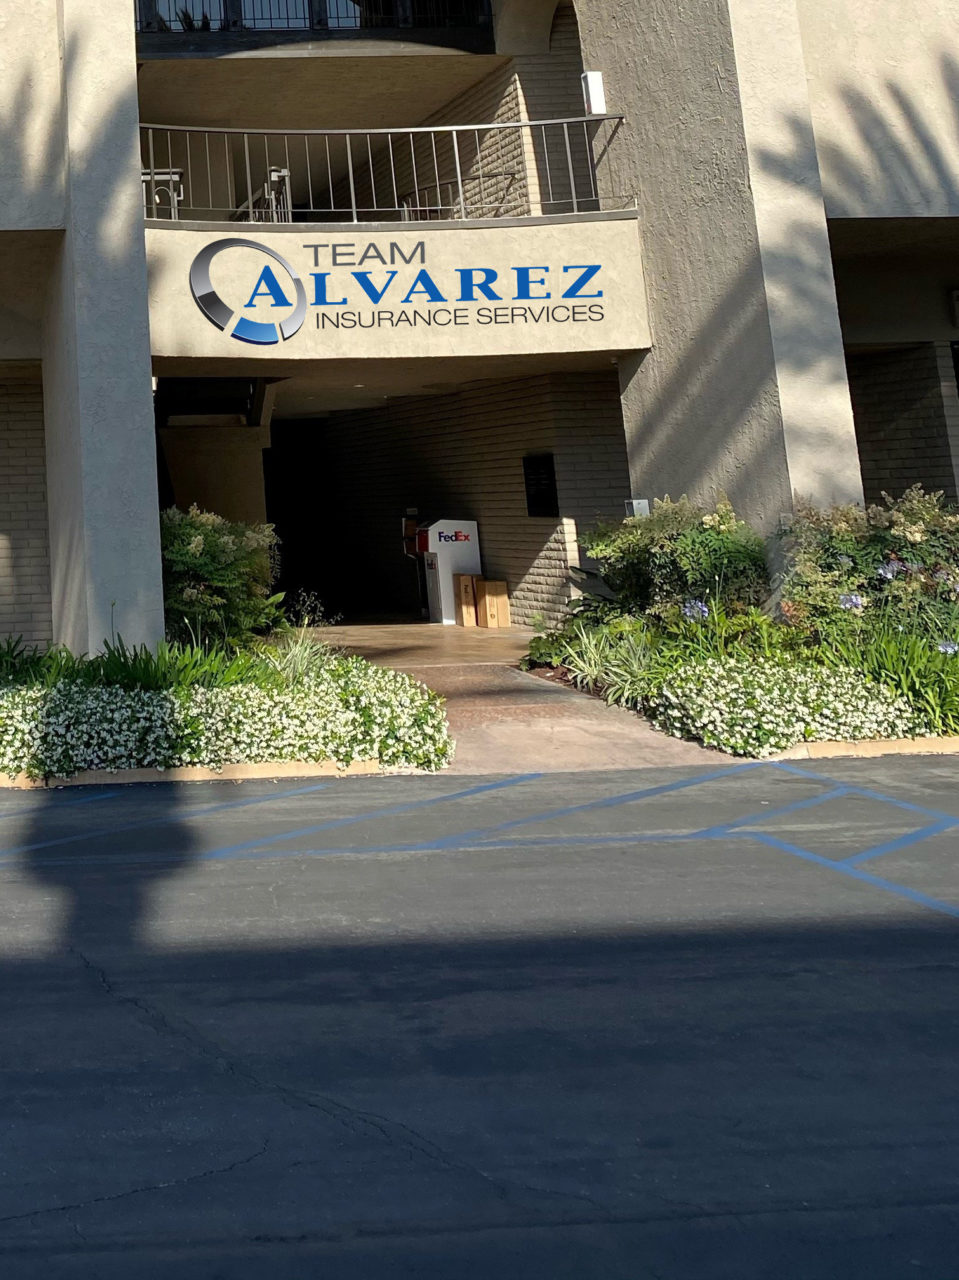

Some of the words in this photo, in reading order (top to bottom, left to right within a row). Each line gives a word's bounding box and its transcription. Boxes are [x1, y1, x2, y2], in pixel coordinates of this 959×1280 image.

[302, 241, 426, 267] TEAM
[243, 264, 603, 308] ALVAREZ
[316, 308, 469, 329] INSURANCE
[476, 304, 605, 325] SERVICES
[438, 531, 471, 543] FedEx
